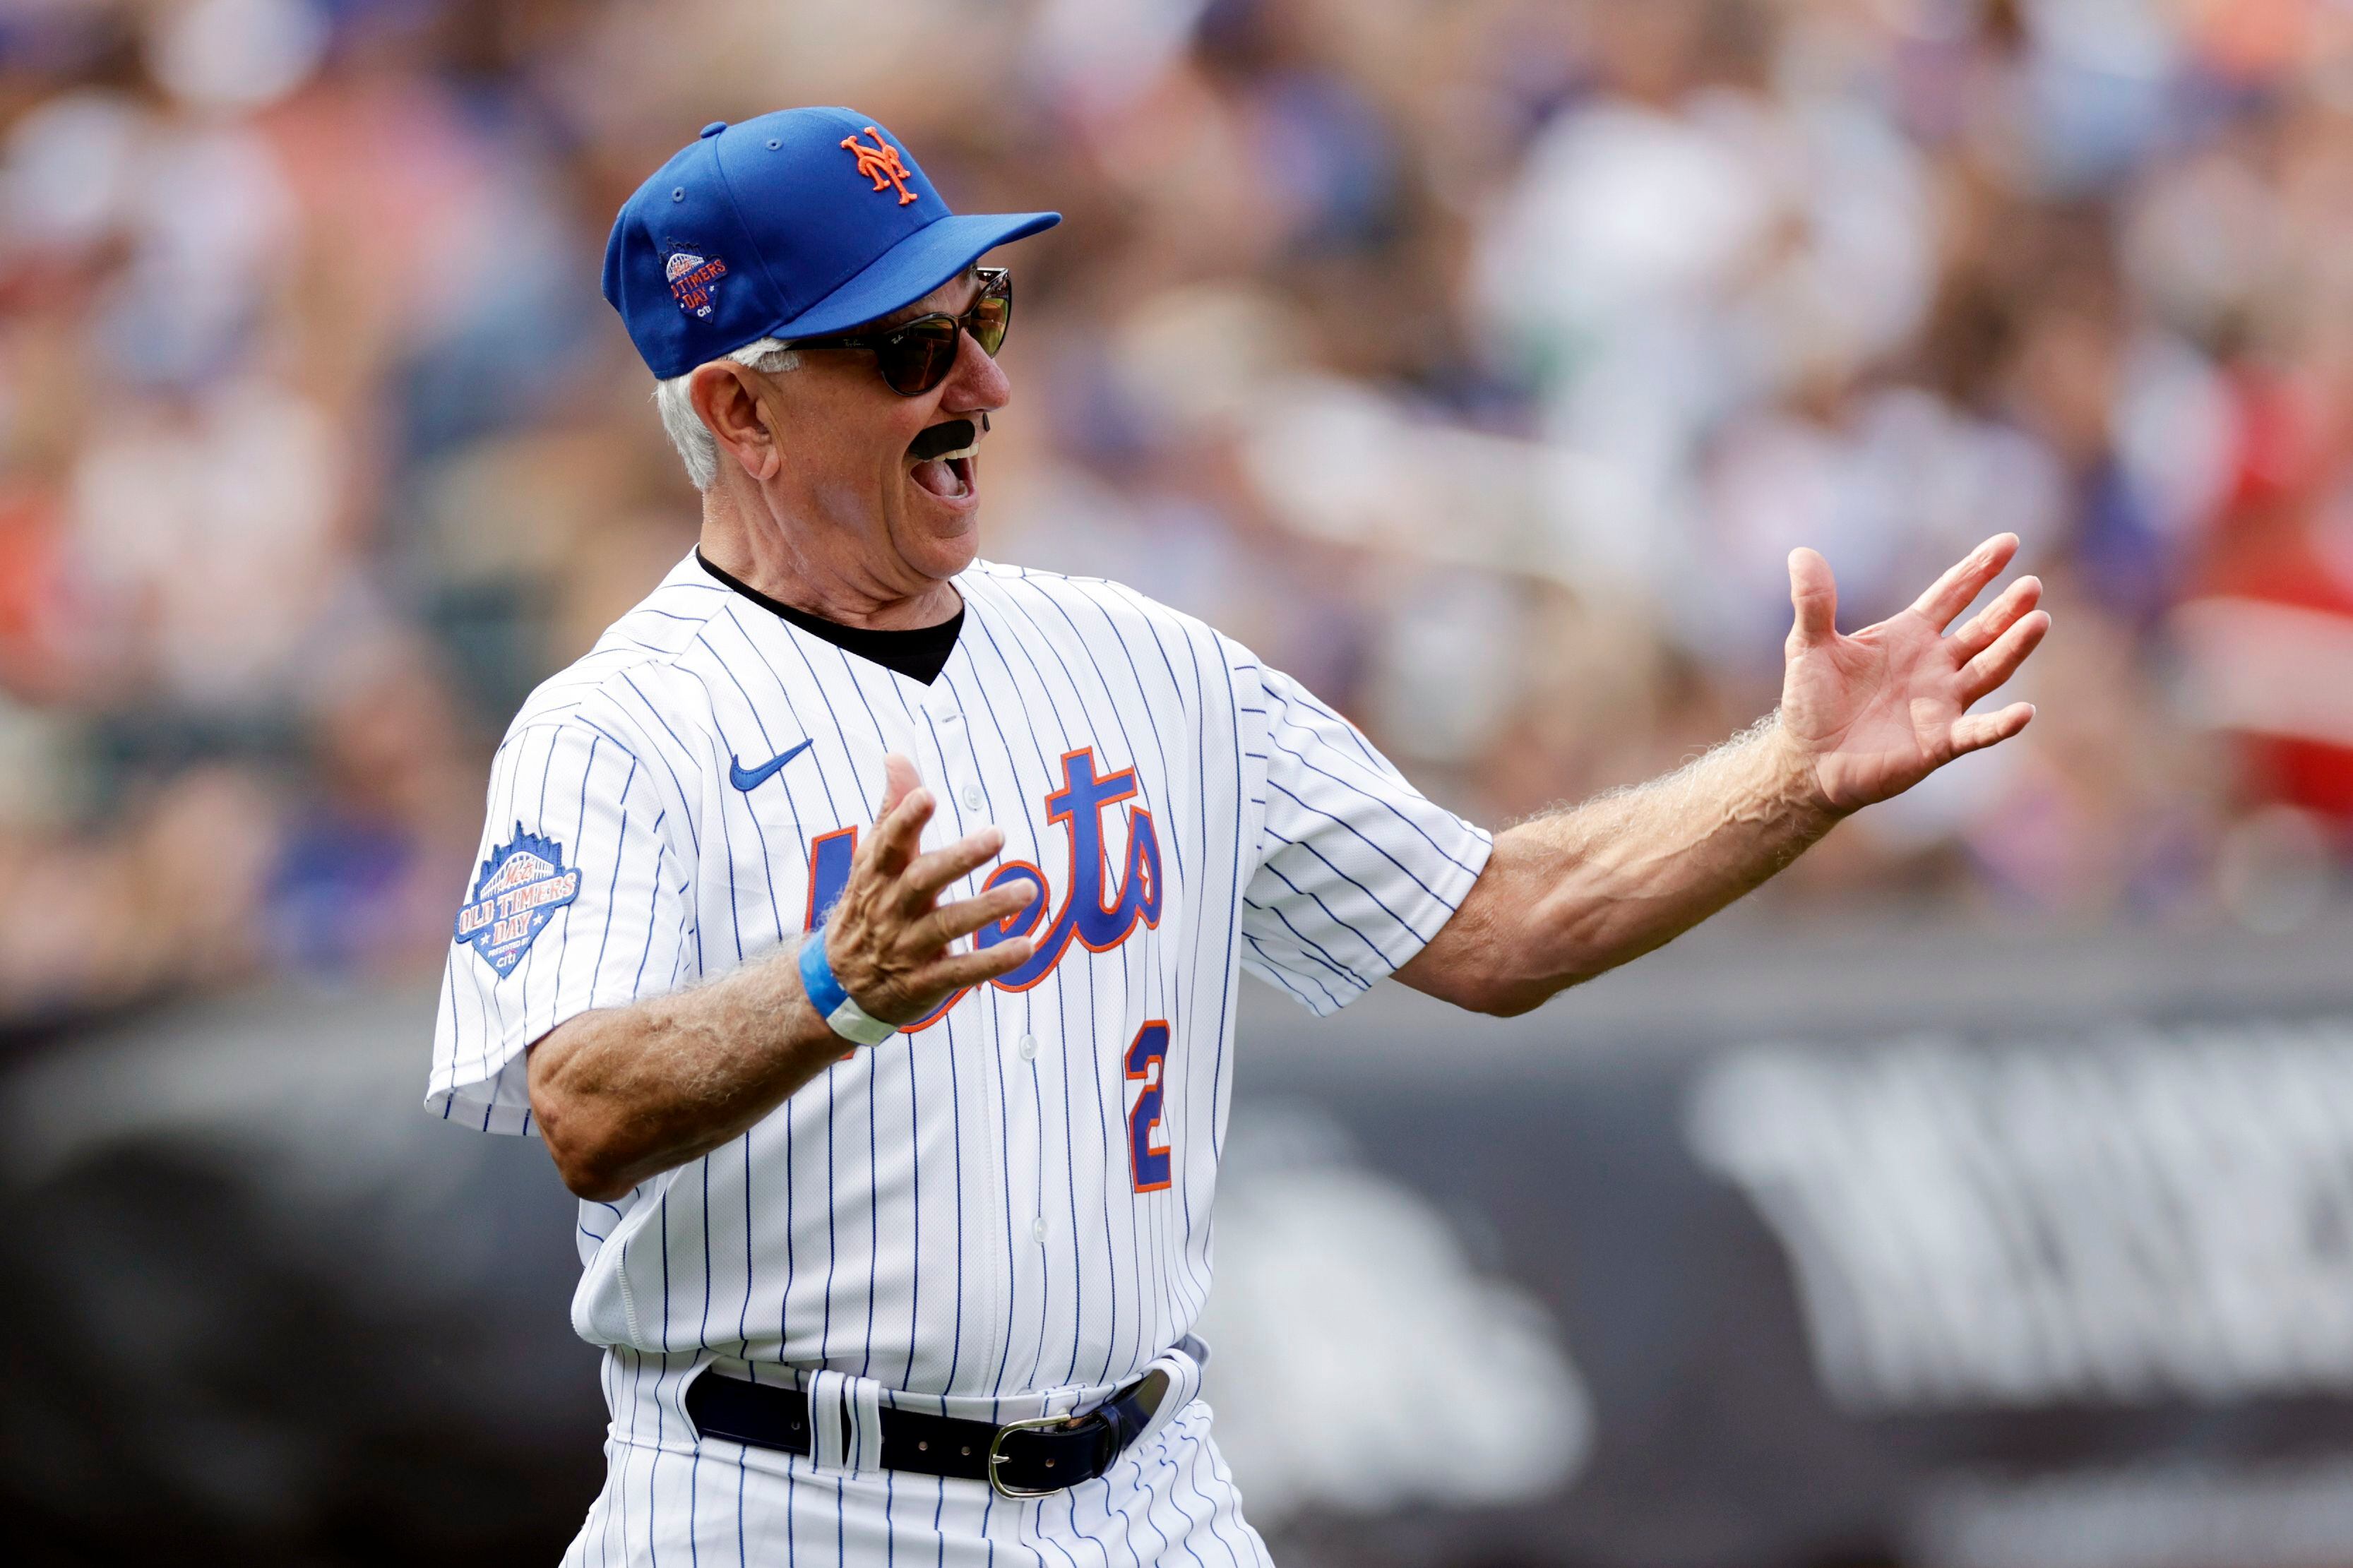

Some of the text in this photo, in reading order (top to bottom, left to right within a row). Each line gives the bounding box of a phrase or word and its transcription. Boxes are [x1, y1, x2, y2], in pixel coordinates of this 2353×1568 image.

[459, 873, 578, 935] OLD TIMERS
[492, 910, 534, 946] DAY
[496, 952, 516, 968] citi
[1124, 1019, 1172, 1193] 2
